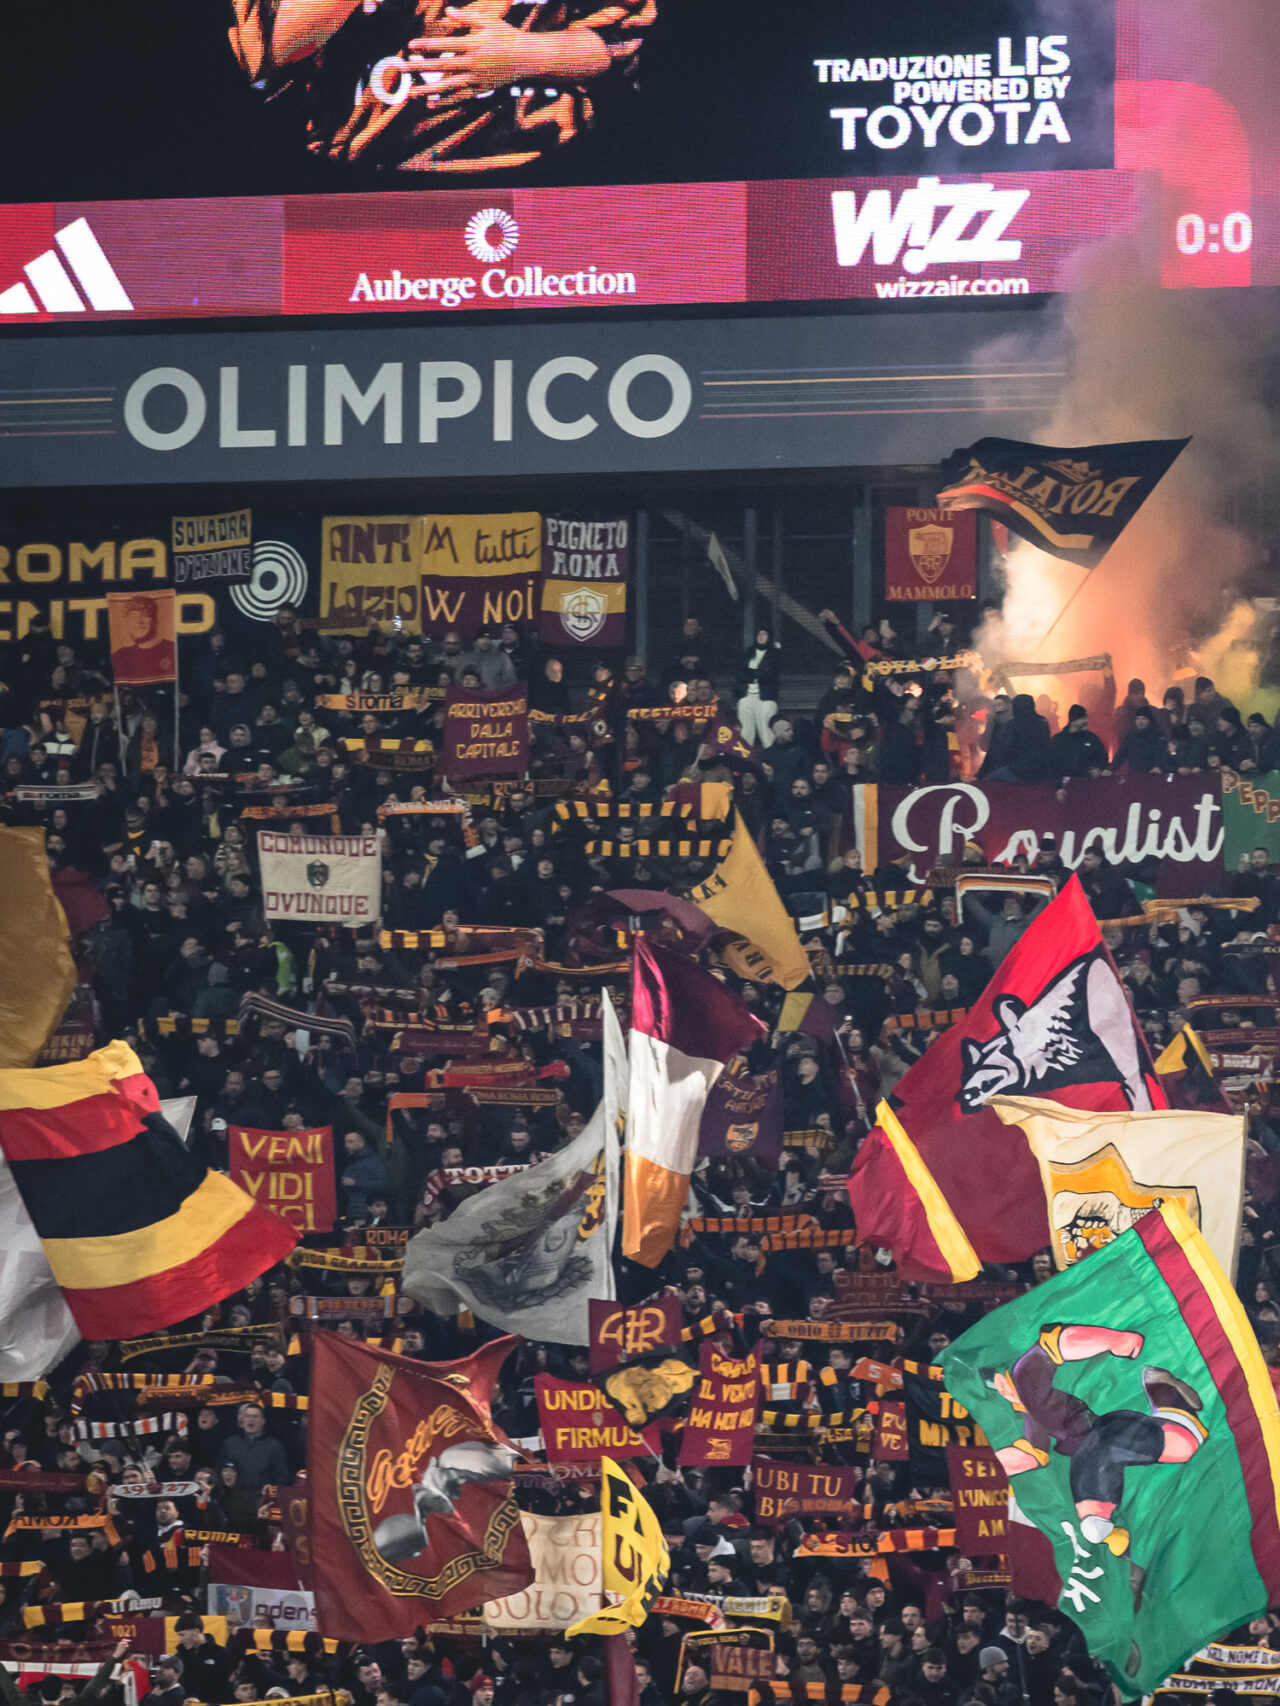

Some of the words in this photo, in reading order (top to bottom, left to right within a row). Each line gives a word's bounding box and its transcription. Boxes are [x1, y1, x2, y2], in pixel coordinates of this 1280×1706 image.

[814, 54, 991, 82] TRADUZIONE
[998, 36, 1070, 76] LIS
[894, 77, 1027, 104] POWERED
[1033, 75, 1070, 100] BY
[830, 103, 1070, 149] TOYOTA
[1176, 212, 1252, 255] 0:0
[350, 269, 475, 306] Auberge
[481, 266, 636, 298] Collection
[875, 275, 1028, 298] wizzair.com
[124, 354, 692, 451] OLIMPICO
[906, 508, 955, 522] PONTE
[175, 512, 249, 547] SQUADRA
[546, 517, 628, 550] PIGNETO
[0, 538, 168, 583] OMA
[552, 551, 620, 578] ROMA
[888, 585, 972, 600] MAMMOLO
[470, 722, 513, 739] DALLA
[456, 740, 521, 760] CAPITALE
[260, 835, 377, 857] COMUNQUE
[266, 892, 370, 917] OVUNQUE
[239, 1132, 325, 1167] VENI
[240, 1171, 315, 1201] VIDI
[698, 1378, 716, 1401] IL
[556, 1427, 644, 1450] FIRMUS
[552, 1465, 601, 1482] OMA
[962, 1458, 997, 1478] SEI
[122, 1484, 143, 1497] 19
[161, 1481, 191, 1494] 27
[756, 1466, 799, 1493] UBI
[807, 1472, 843, 1498] TU
[184, 1528, 241, 1545] ROMA
[711, 1644, 774, 1677] VALE
